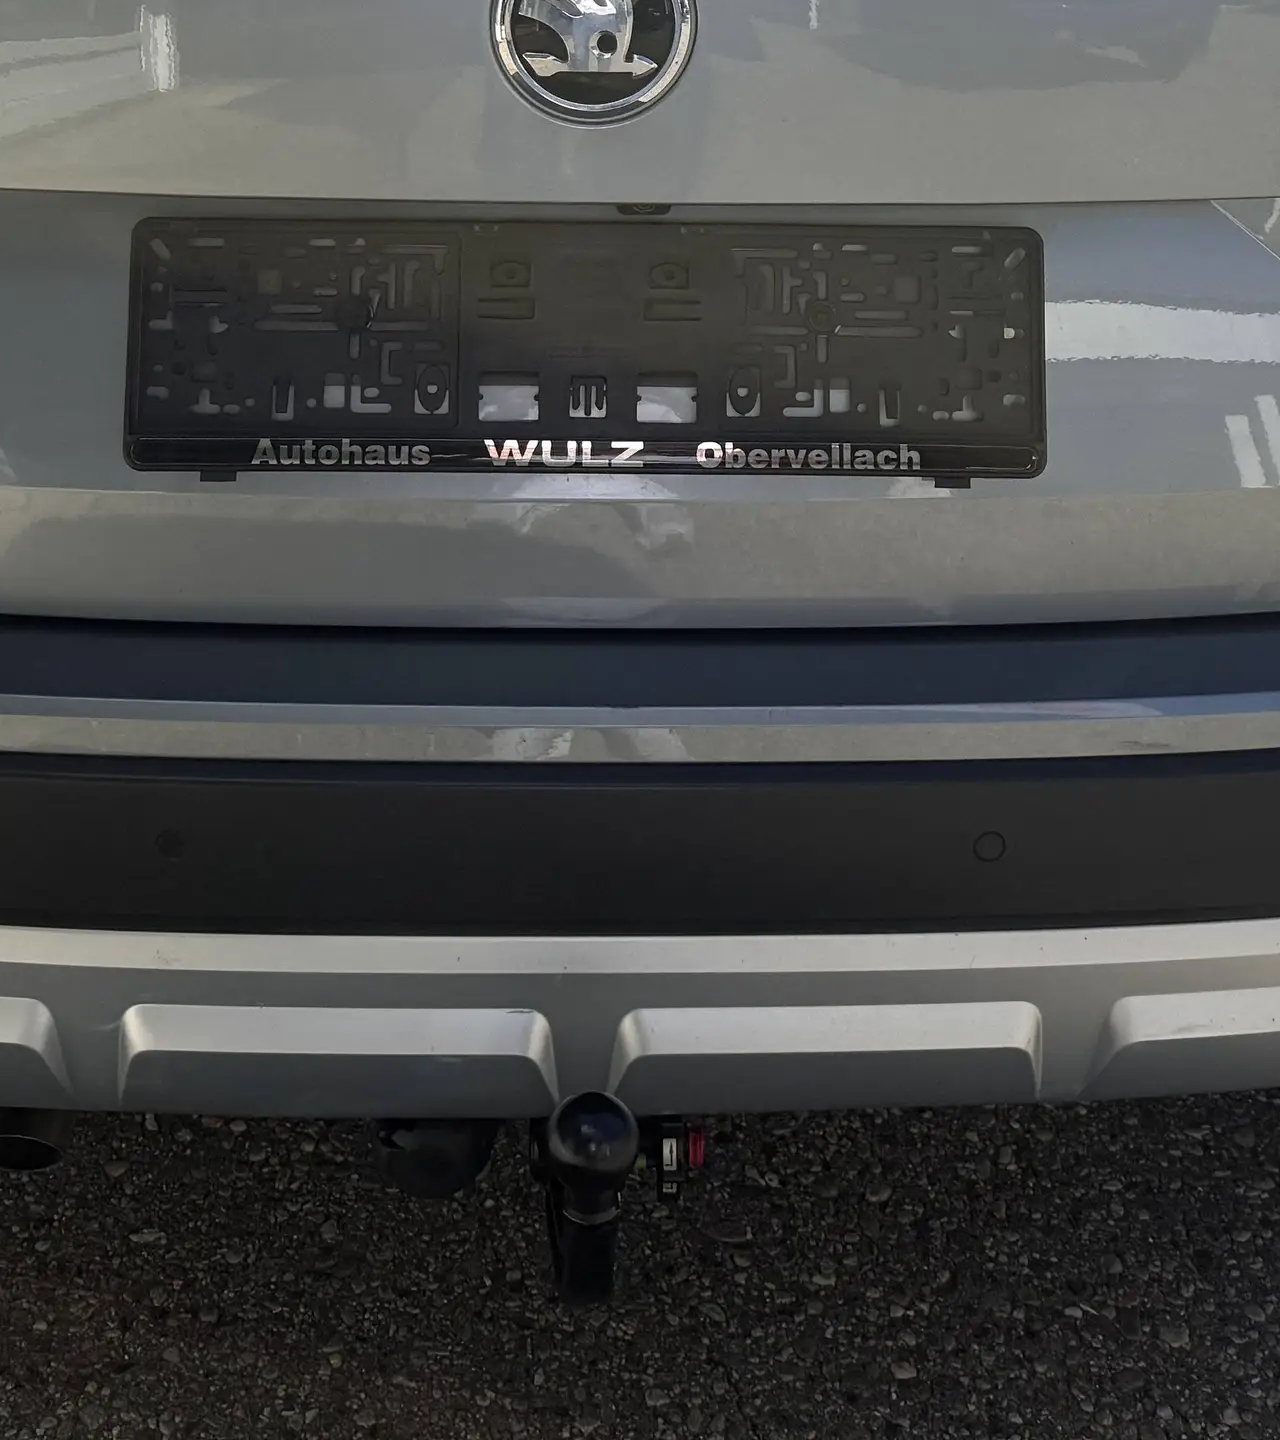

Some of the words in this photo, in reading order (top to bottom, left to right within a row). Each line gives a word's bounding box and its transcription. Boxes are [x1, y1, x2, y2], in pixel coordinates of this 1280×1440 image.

[251, 438, 431, 466] Autohaus
[483, 439, 644, 467] WULZ
[696, 441, 920, 470] Obervellach
